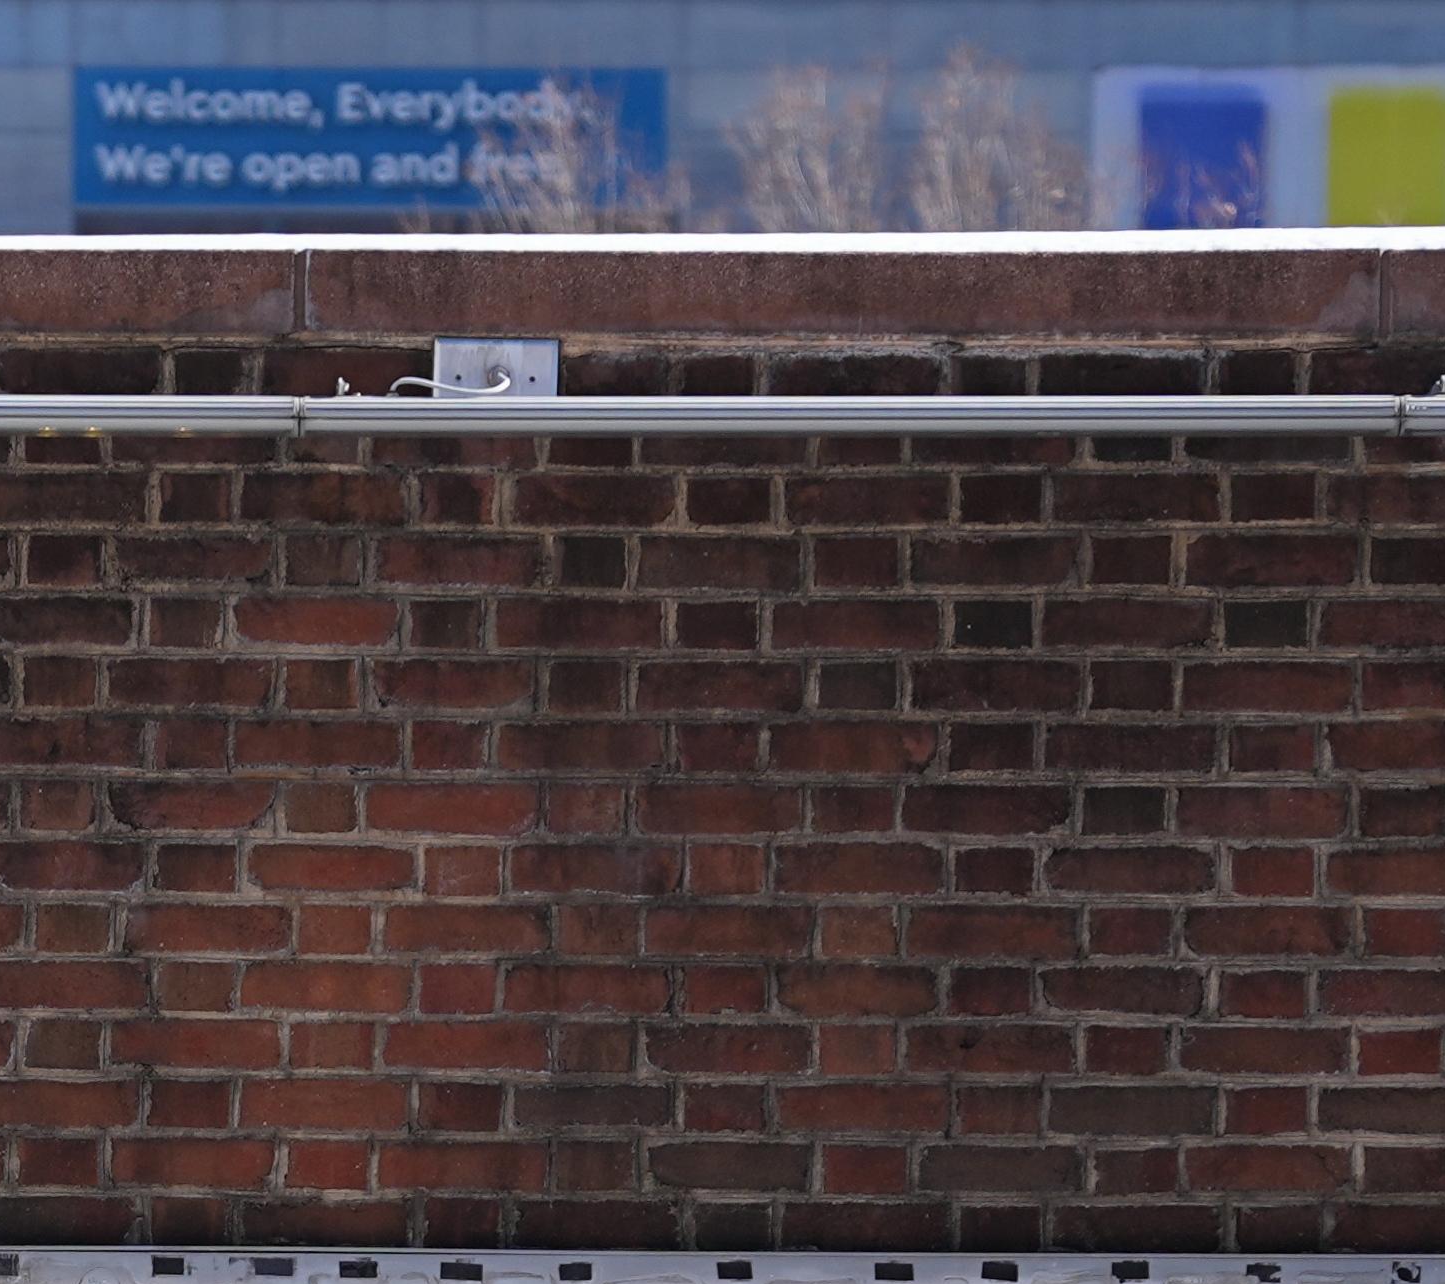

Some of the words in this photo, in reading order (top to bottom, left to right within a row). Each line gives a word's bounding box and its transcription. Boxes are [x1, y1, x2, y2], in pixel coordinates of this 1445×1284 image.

[95, 78, 324, 129] Welcome,
[95, 144, 232, 183] We're
[241, 152, 360, 191] open
[370, 143, 458, 183] and
